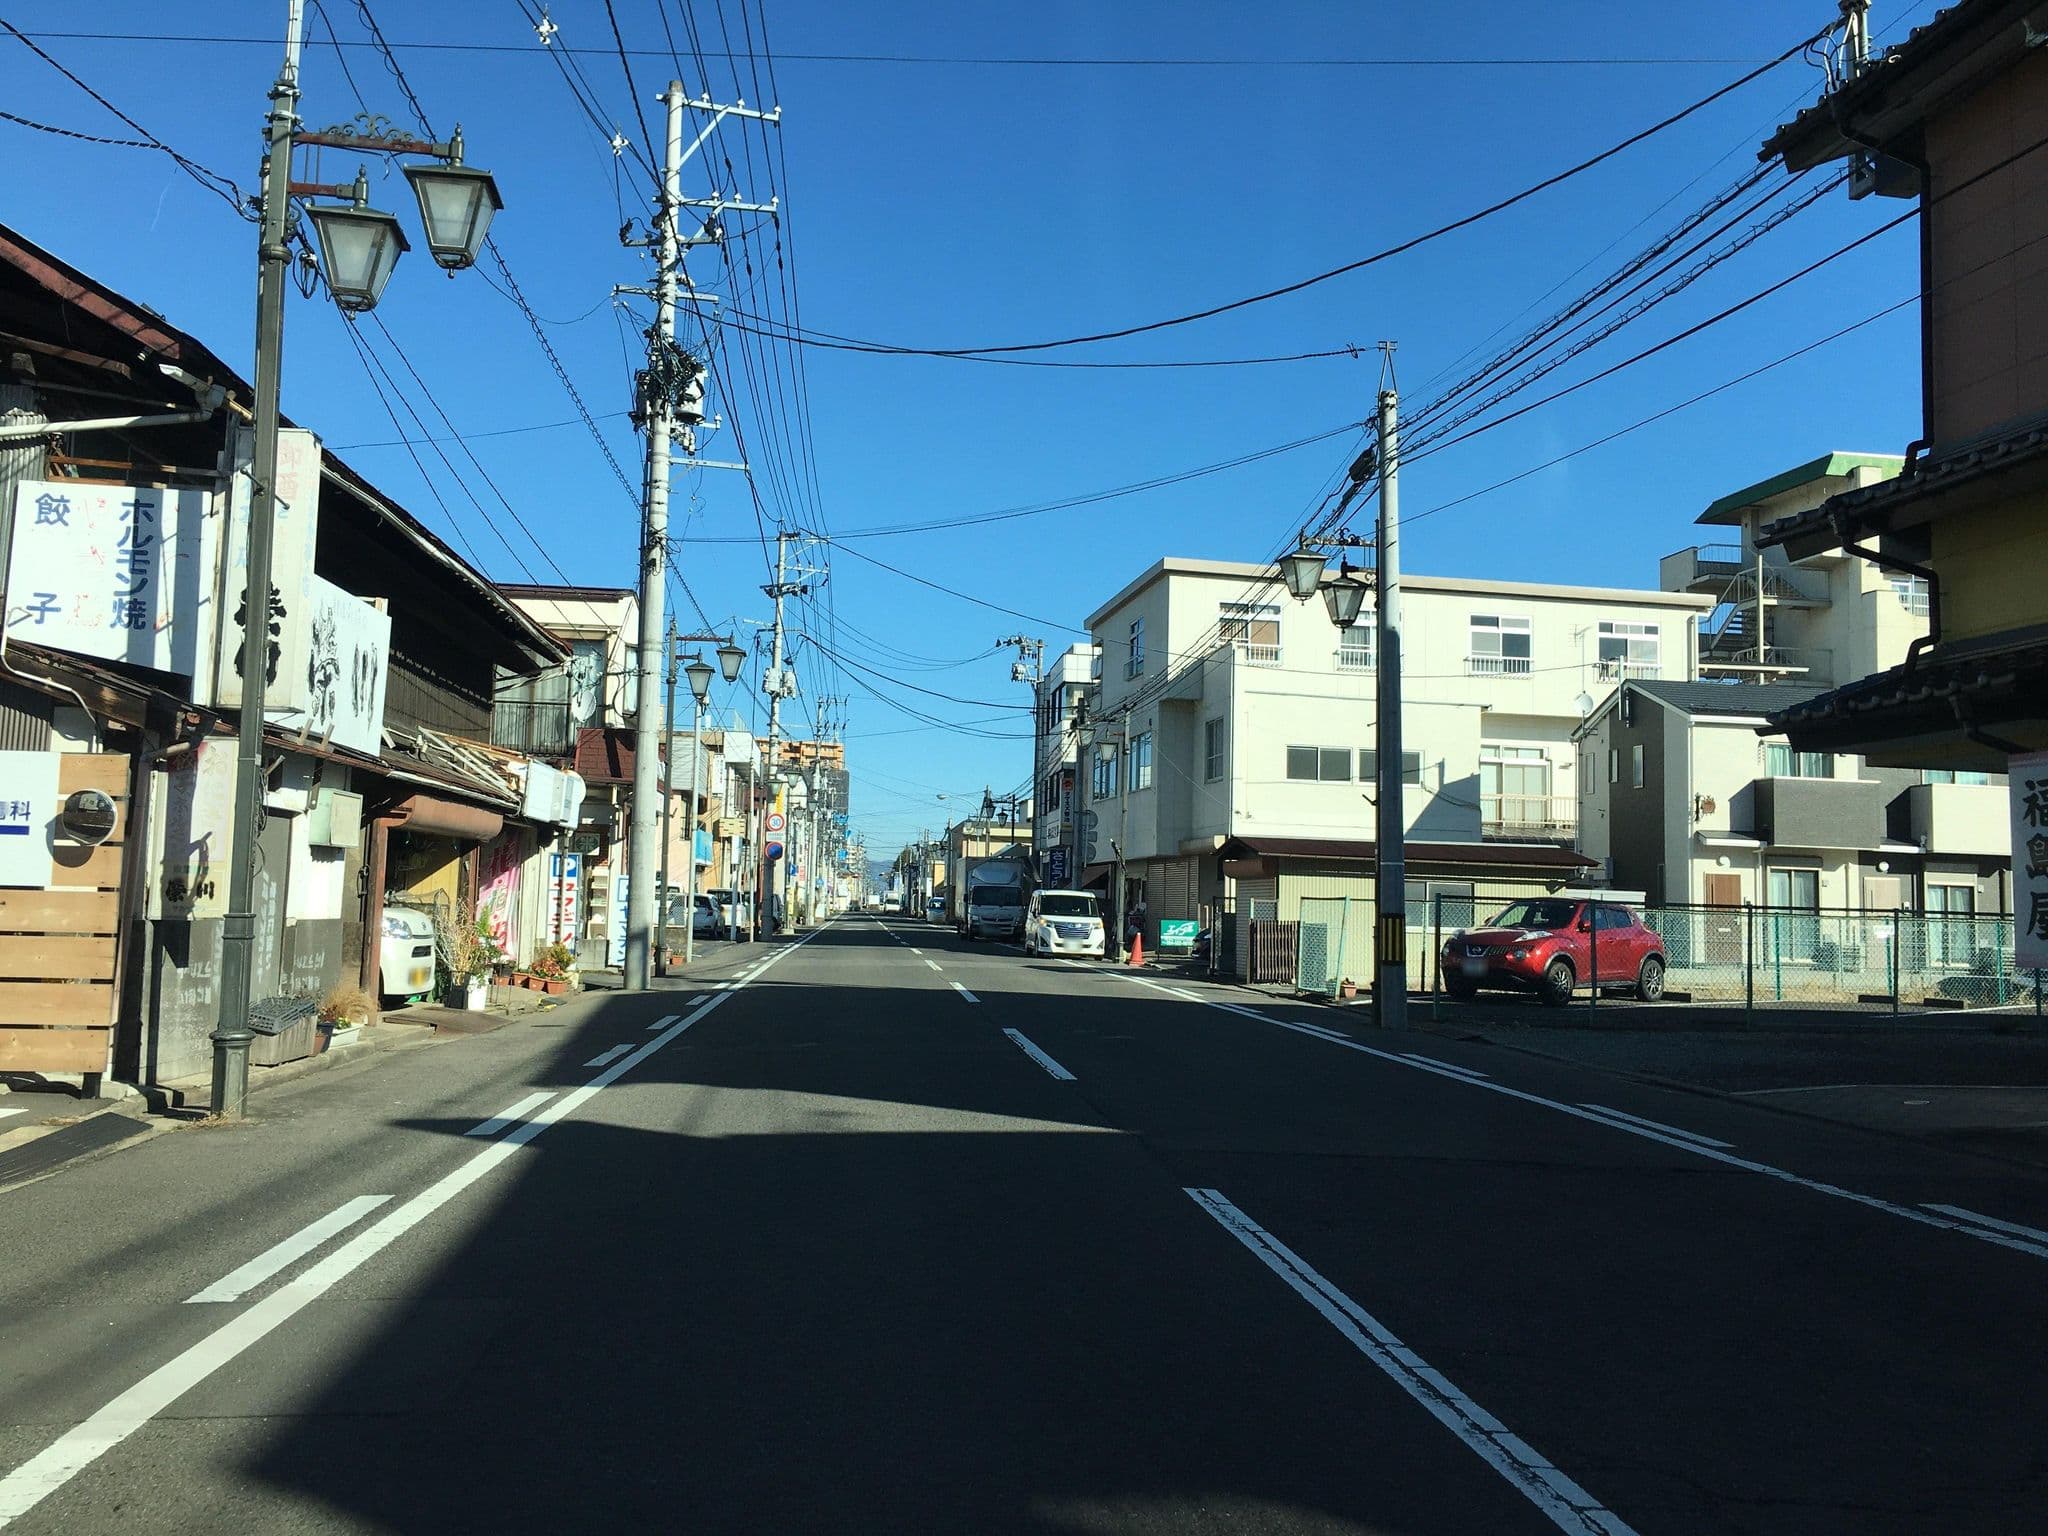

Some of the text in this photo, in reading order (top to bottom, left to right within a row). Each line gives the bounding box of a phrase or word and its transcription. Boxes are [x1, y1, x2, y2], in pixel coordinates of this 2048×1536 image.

[26, 492, 71, 625] 餃子
[109, 498, 155, 631] ホルモン焼
